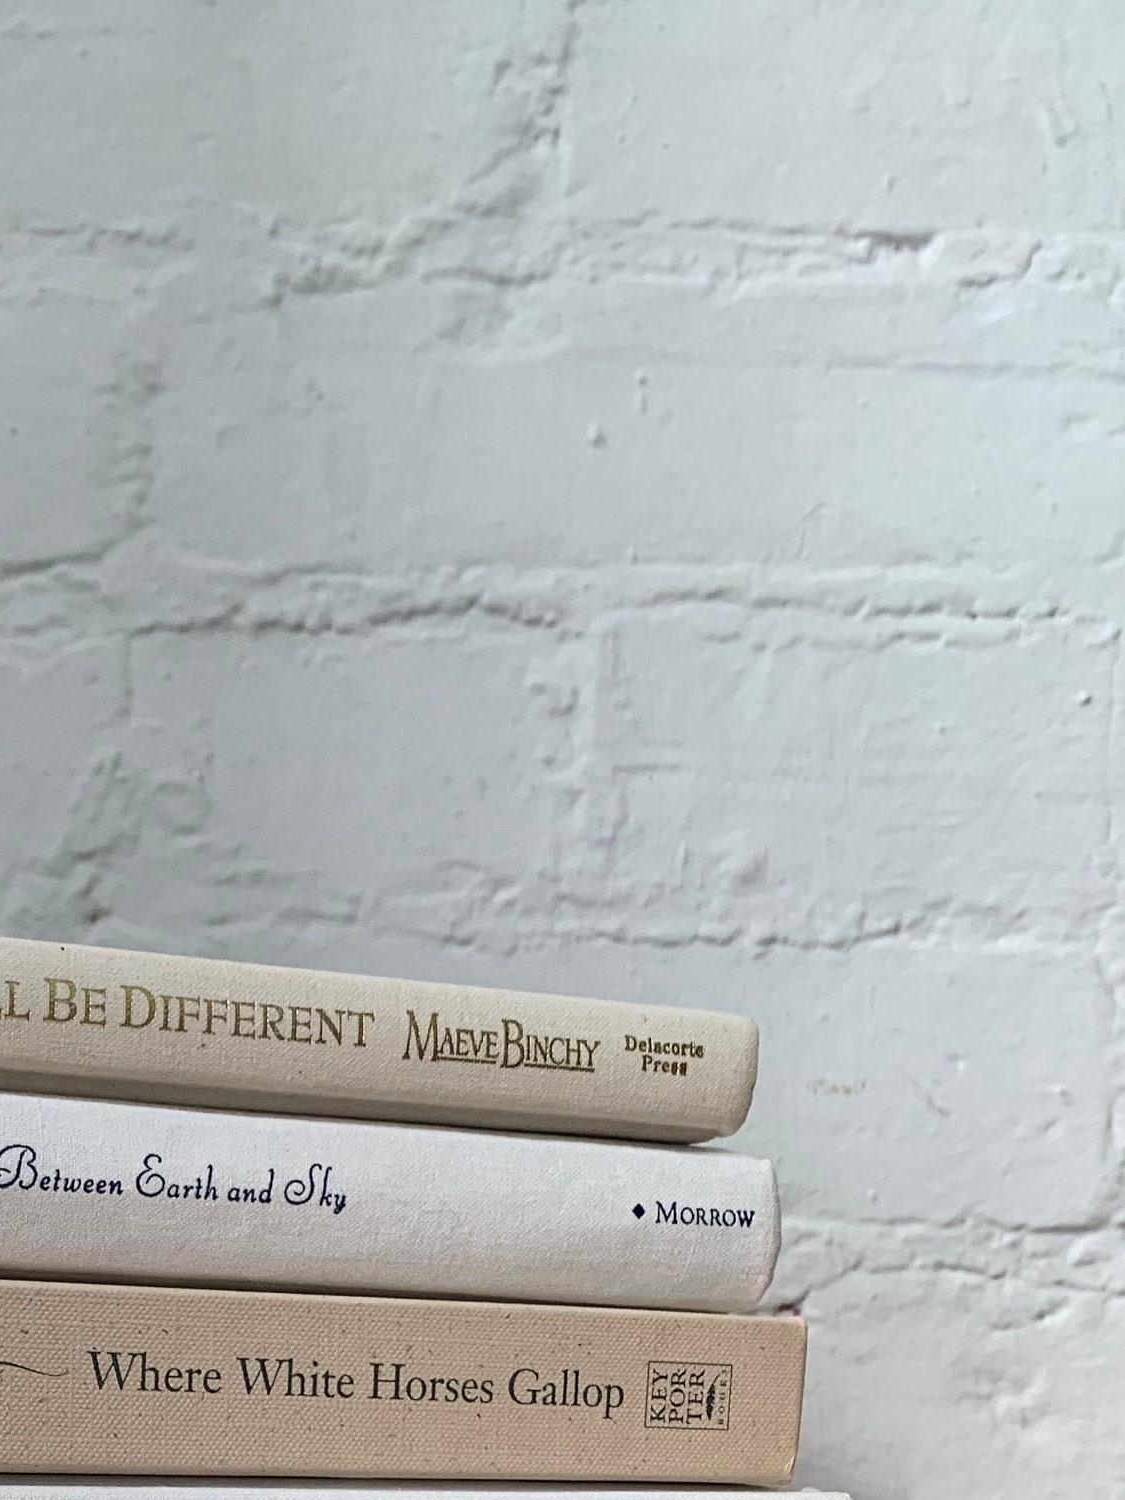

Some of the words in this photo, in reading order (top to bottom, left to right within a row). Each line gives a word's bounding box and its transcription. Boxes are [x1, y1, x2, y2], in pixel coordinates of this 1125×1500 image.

[43, 978, 107, 1028] BE
[119, 985, 375, 1048] DIFFERENT
[625, 1034, 705, 1059] Delacorte
[641, 1054, 687, 1077] Press
[136, 1153, 218, 1201] Earth
[227, 1168, 274, 1204] and
[284, 1164, 346, 1215] Sky
[656, 1201, 755, 1228] MORROW
[87, 1351, 221, 1393] Where
[236, 1357, 354, 1398] White
[368, 1363, 494, 1403] Horses
[508, 1368, 624, 1419] Gallop
[650, 1368, 668, 1423] KEY
[668, 1368, 687, 1424] POR
[686, 1368, 705, 1424] TER
